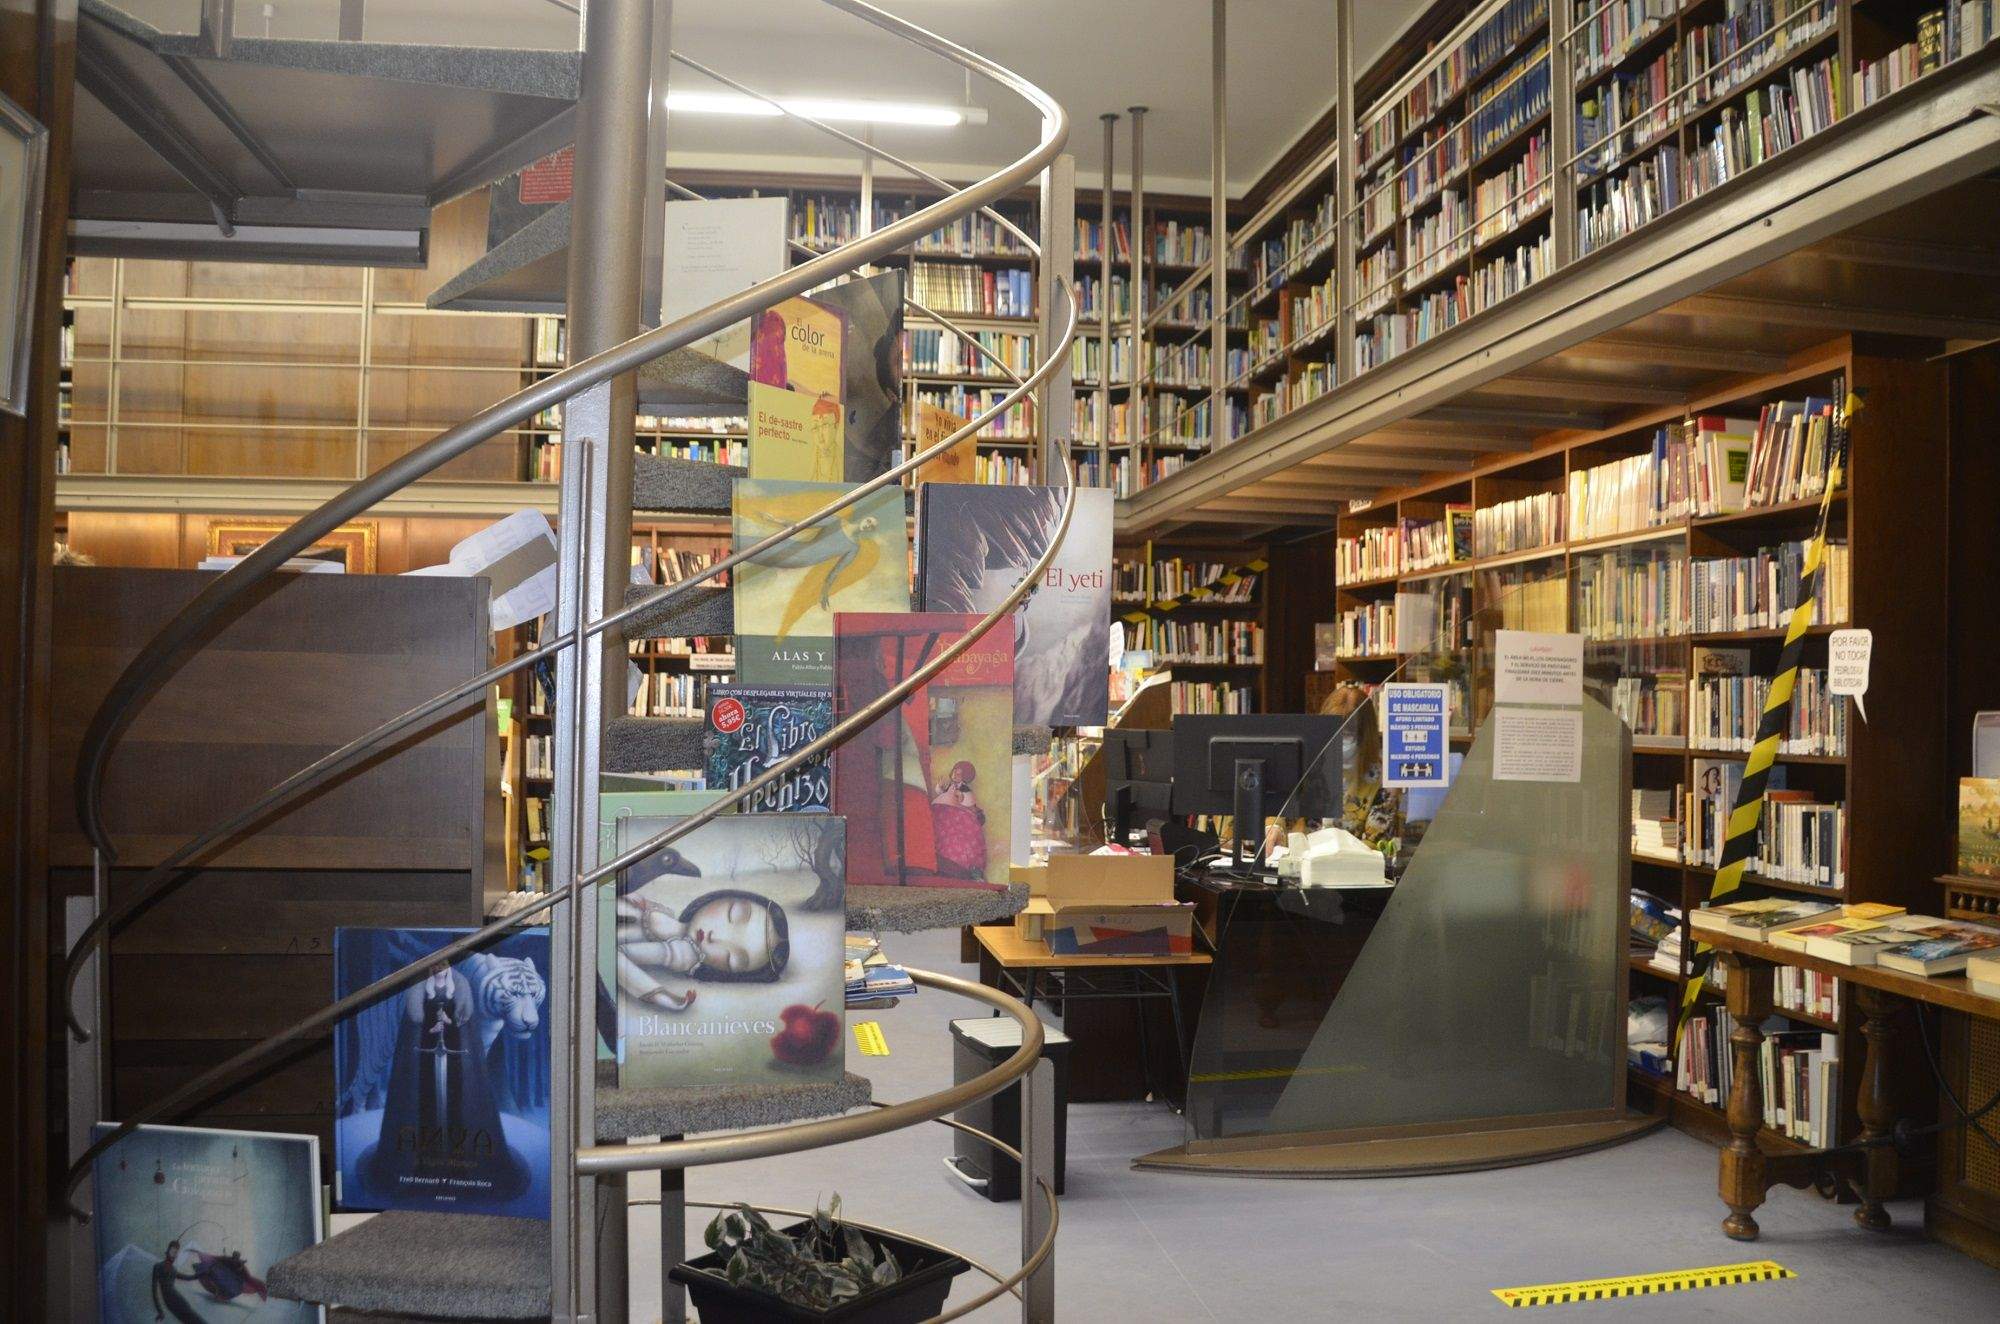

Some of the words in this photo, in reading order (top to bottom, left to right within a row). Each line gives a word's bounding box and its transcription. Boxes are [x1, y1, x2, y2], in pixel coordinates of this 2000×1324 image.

[791, 324, 825, 346] color
[758, 411, 766, 422] El
[769, 414, 802, 431] de-sastre
[758, 426, 790, 440] perfecto
[1046, 568, 1062, 587] El
[1068, 570, 1102, 592] yeti
[1832, 636, 1847, 646] POR
[772, 651, 809, 660] ALAS
[816, 652, 826, 661] Y
[1393, 704, 1401, 712] DE
[1402, 704, 1439, 712] MASCARILLA
[739, 723, 761, 751] El
[763, 705, 816, 768] Libro
[639, 1015, 775, 1036] Blancanieves
